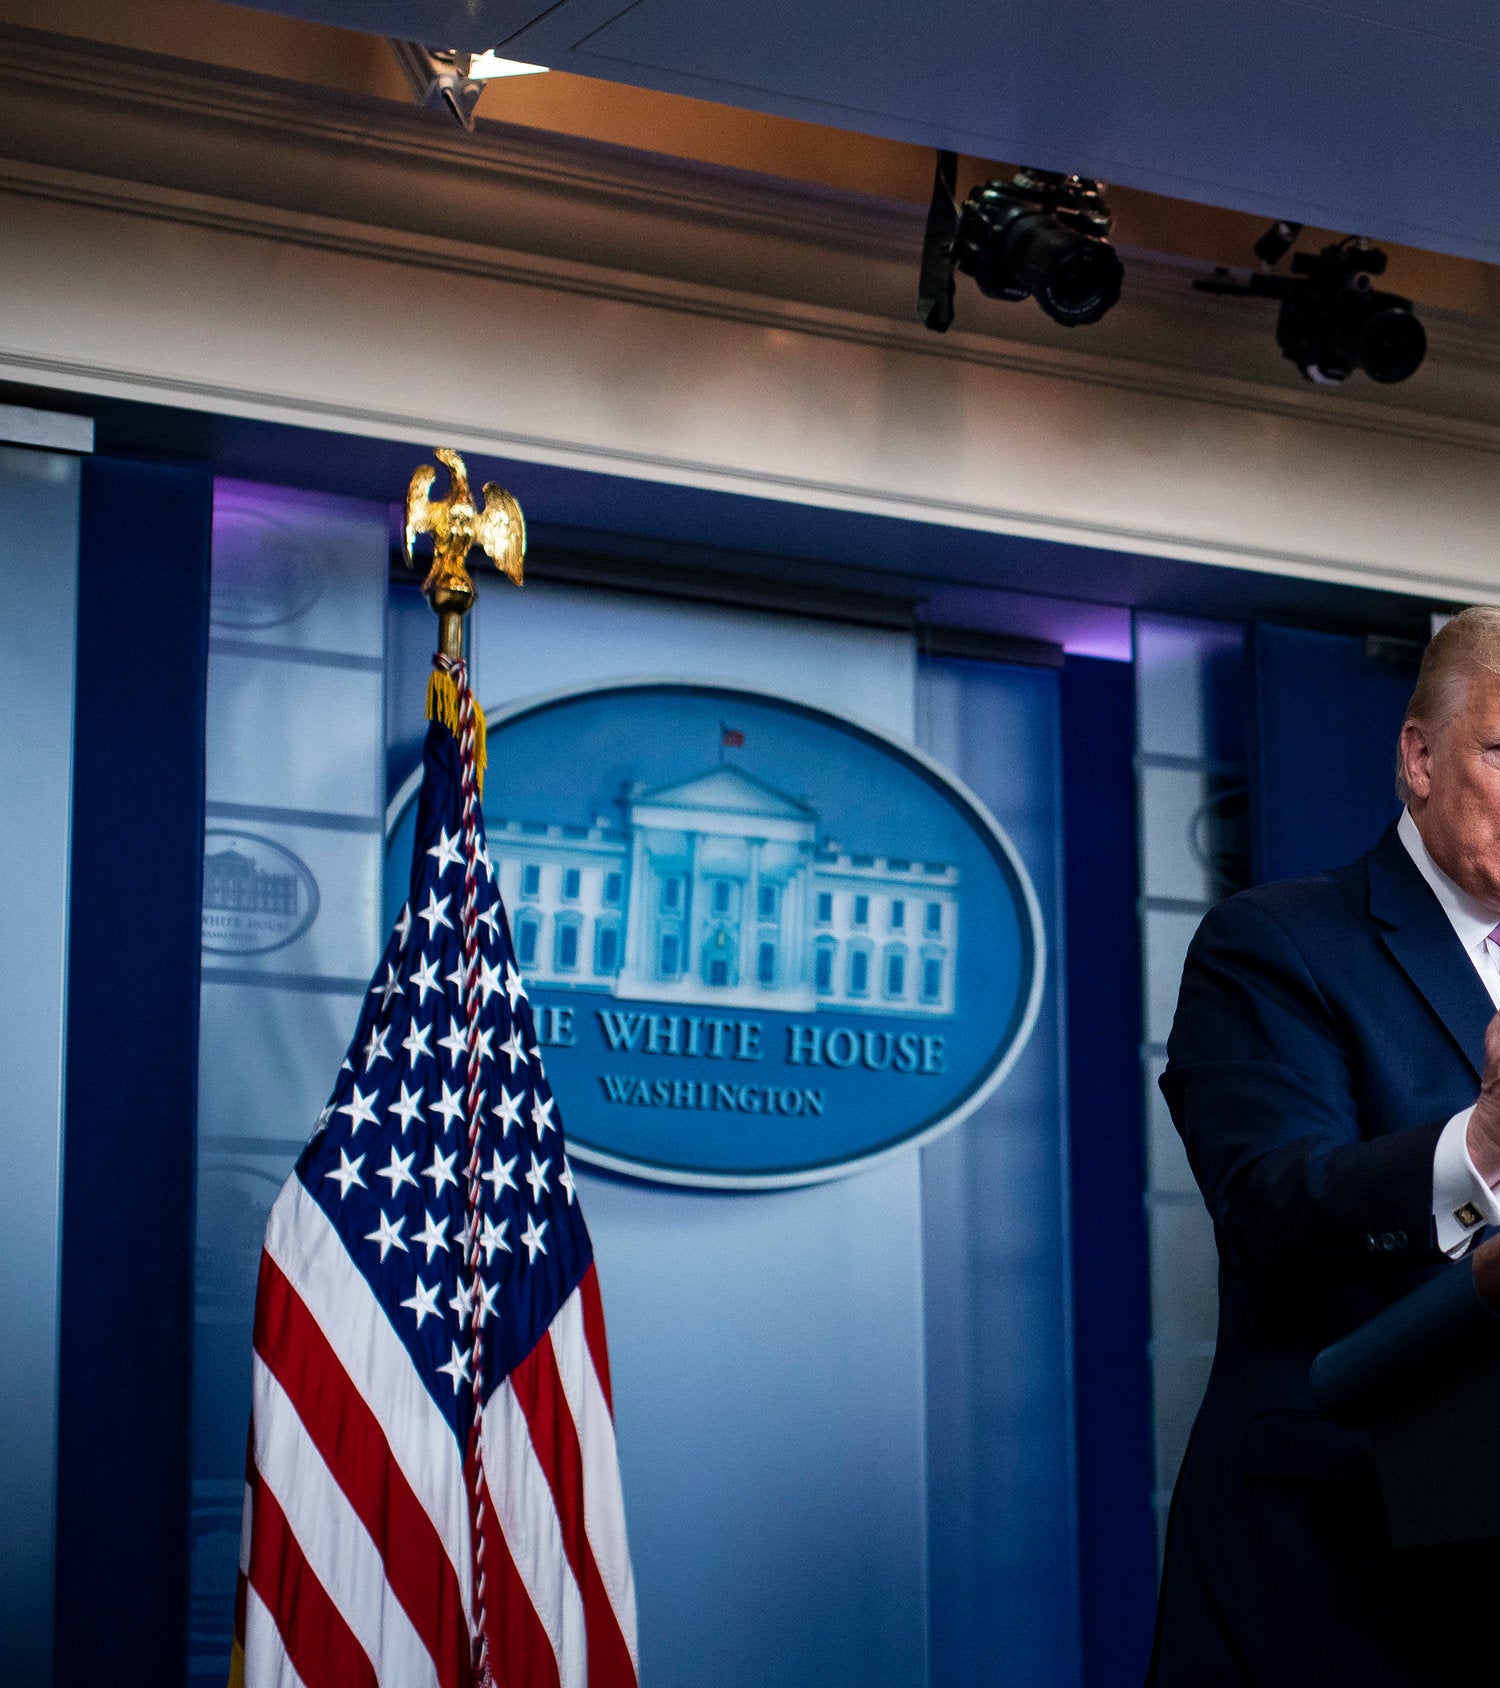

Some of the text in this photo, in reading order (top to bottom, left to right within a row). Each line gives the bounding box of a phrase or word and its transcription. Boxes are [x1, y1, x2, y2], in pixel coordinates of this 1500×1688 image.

[600, 1010, 763, 1060] WHITE
[788, 1027, 947, 1073] HOUSE
[601, 1073, 824, 1117] WASHINGTON
